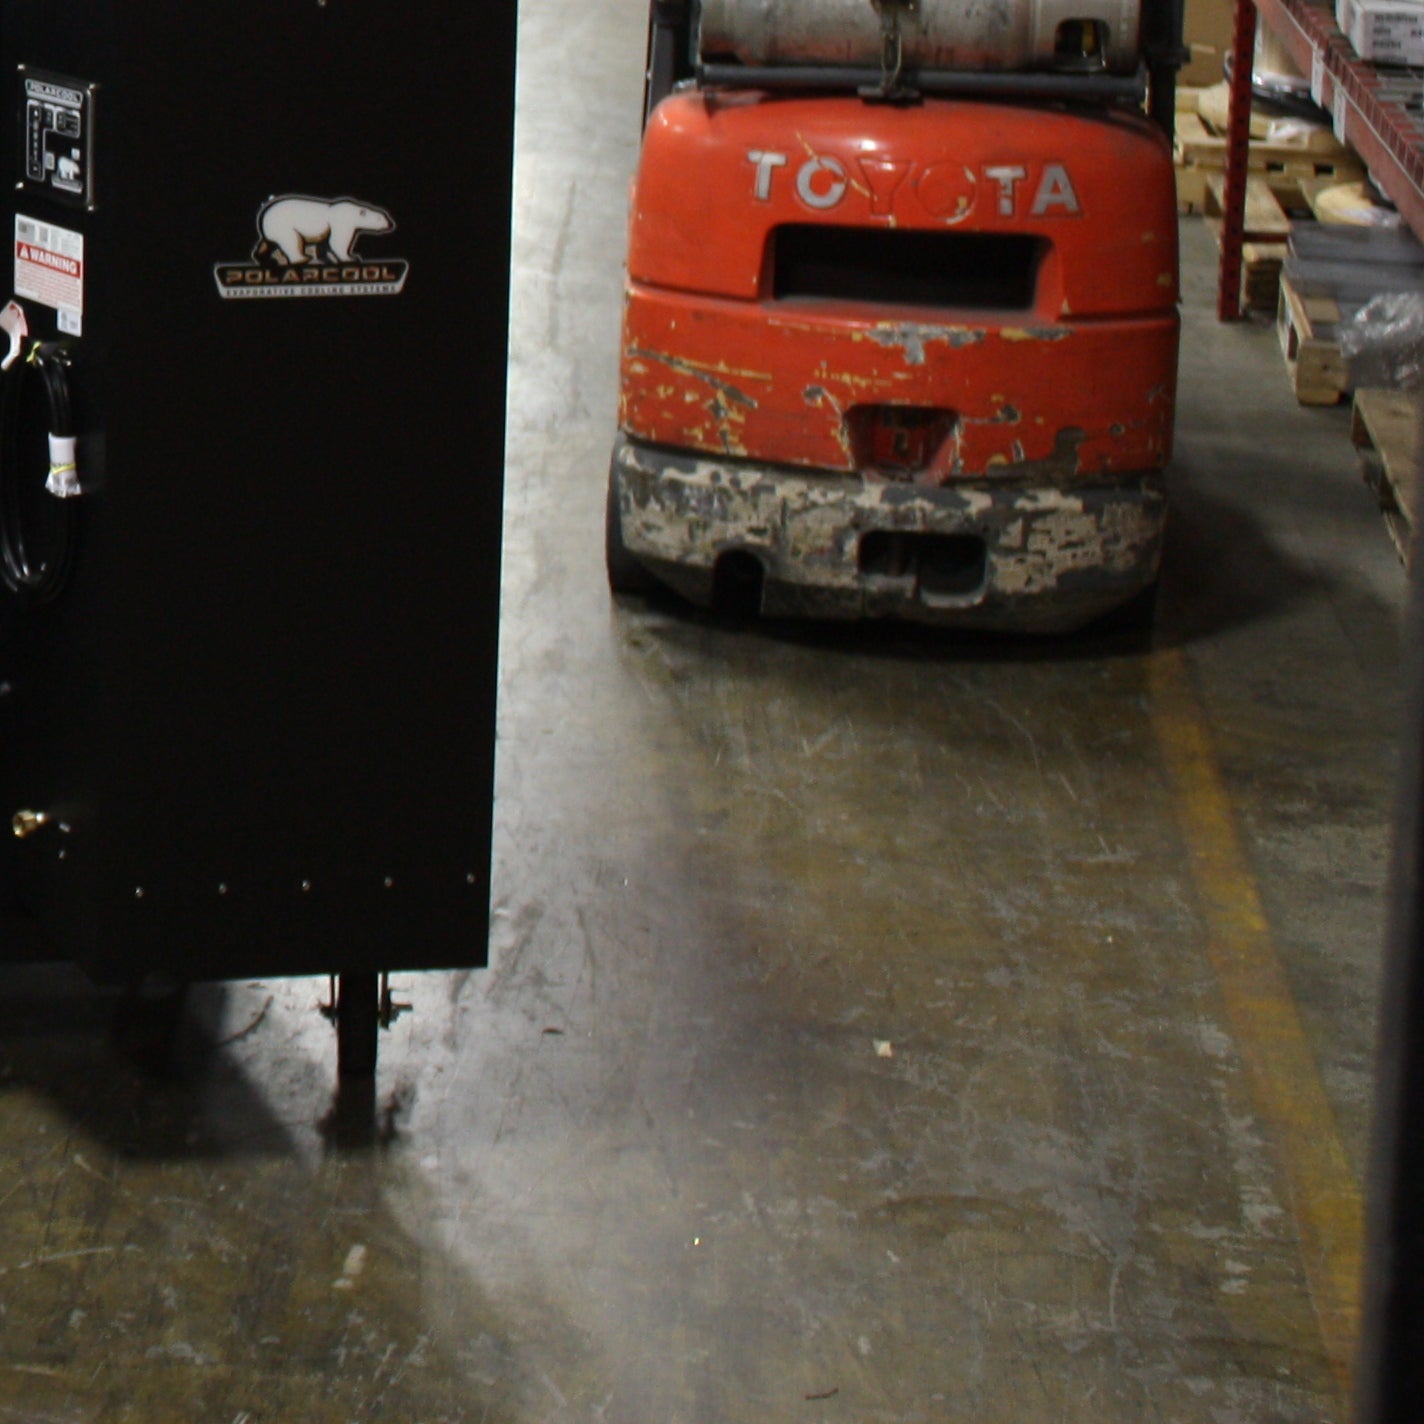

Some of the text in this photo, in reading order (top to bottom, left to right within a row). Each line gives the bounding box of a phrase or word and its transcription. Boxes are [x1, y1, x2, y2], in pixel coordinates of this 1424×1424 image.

[746, 150, 1083, 219] TOYOTA
[29, 247, 79, 274] WARNING
[225, 266, 397, 284] POLARCOOL
[300, 286, 344, 295] COOLING
